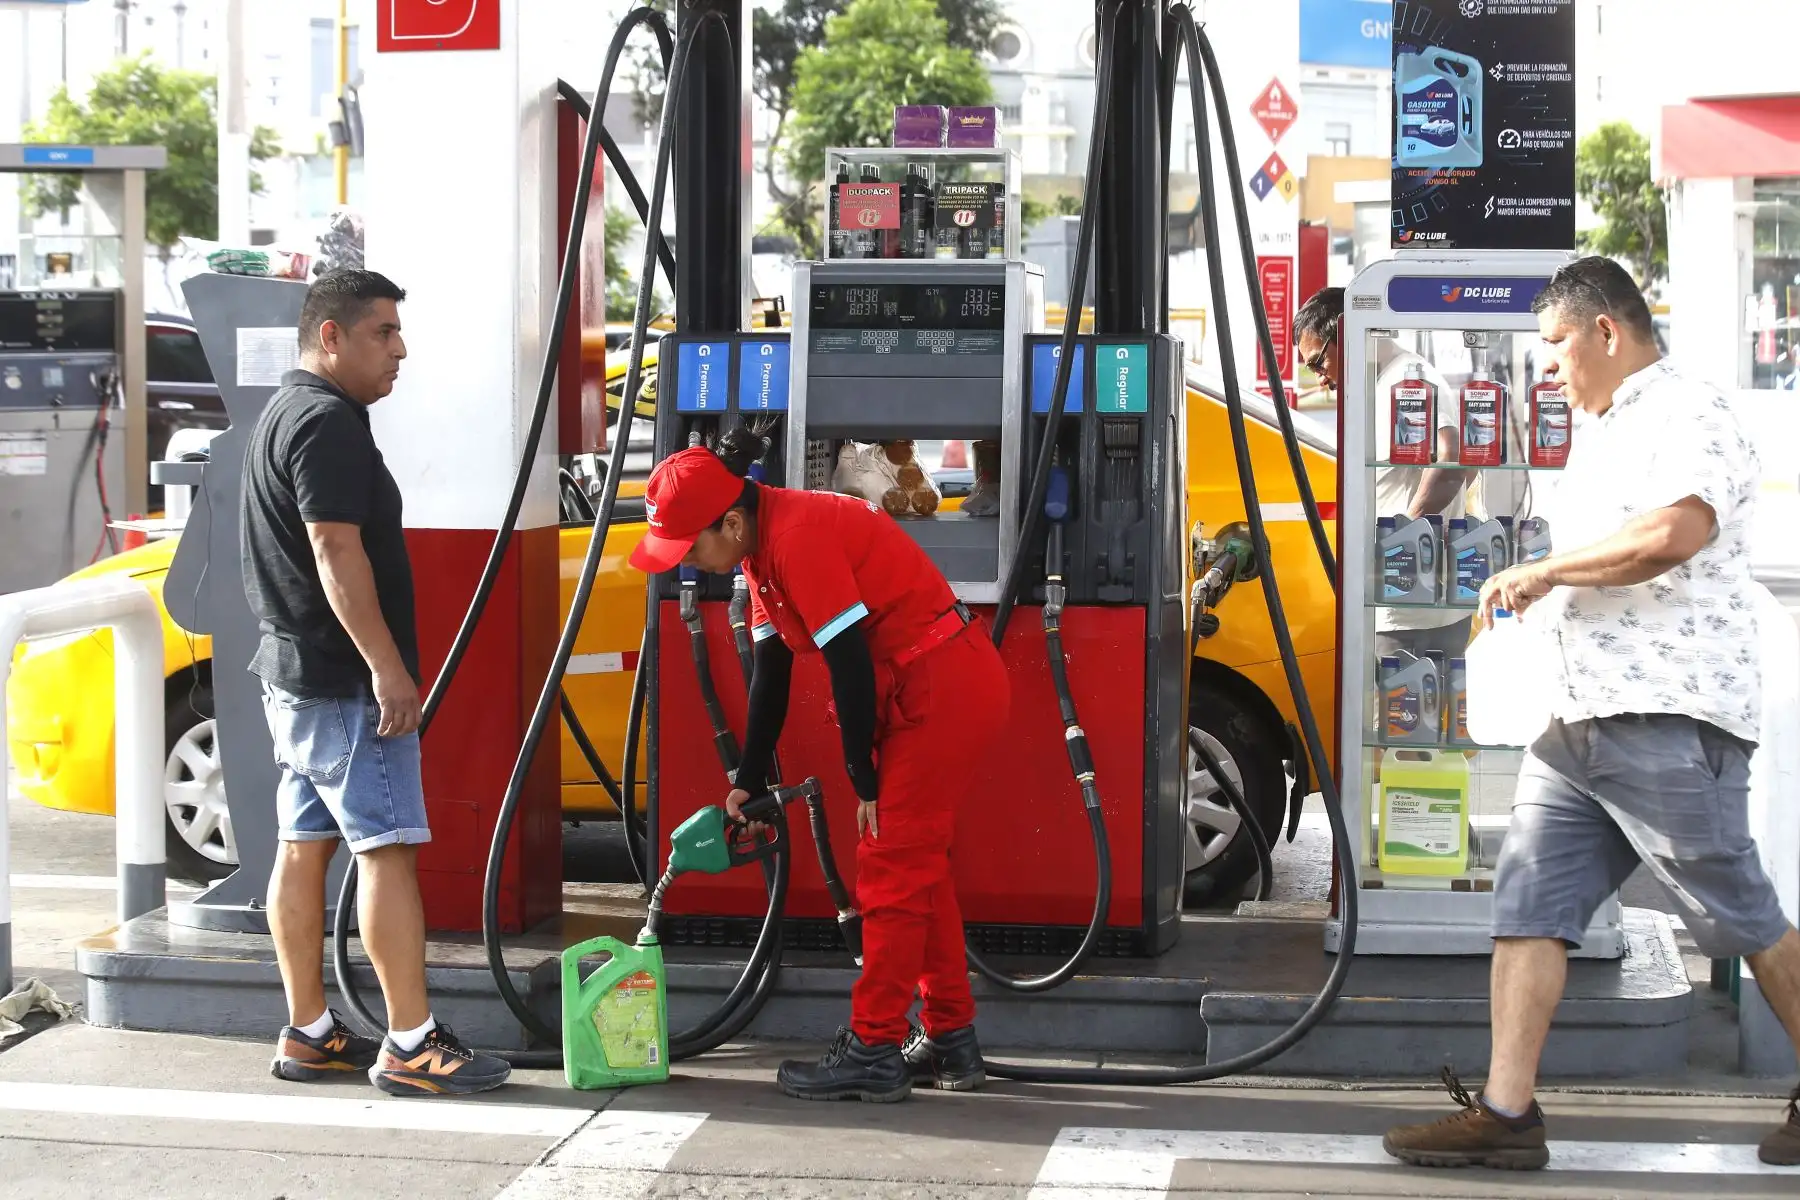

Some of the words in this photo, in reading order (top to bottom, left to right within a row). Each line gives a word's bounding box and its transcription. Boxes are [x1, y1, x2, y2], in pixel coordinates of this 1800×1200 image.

[1361, 19, 1392, 39] GN
[1507, 64, 1530, 72] PREVIENE
[1507, 73, 1514, 81] DE
[1546, 73, 1572, 81] CRISTALES
[1408, 101, 1447, 109] GASOTREX
[1523, 130, 1535, 138] PARA
[1270, 161, 1278, 175] 4
[945, 186, 987, 194] TRIPACK
[1257, 177, 1263, 192] 1
[1285, 180, 1292, 192] 0
[848, 188, 893, 196] DUOPACK
[1498, 198, 1517, 206] MEJORA
[1518, 198, 1524, 206] LA
[1558, 198, 1572, 206] PARA
[1498, 208, 1514, 216] MAYOR
[1515, 208, 1552, 216] PERFORMANCE
[1414, 232, 1426, 240] DC
[1427, 232, 1447, 240] LUBE
[1464, 287, 1481, 298] DC
[1482, 287, 1512, 298] LUBE
[699, 345, 711, 357] G
[760, 344, 773, 356] G
[1116, 348, 1128, 360] G
[700, 364, 709, 408] Premium
[761, 363, 772, 408] Premium
[1117, 367, 1129, 410] Regular
